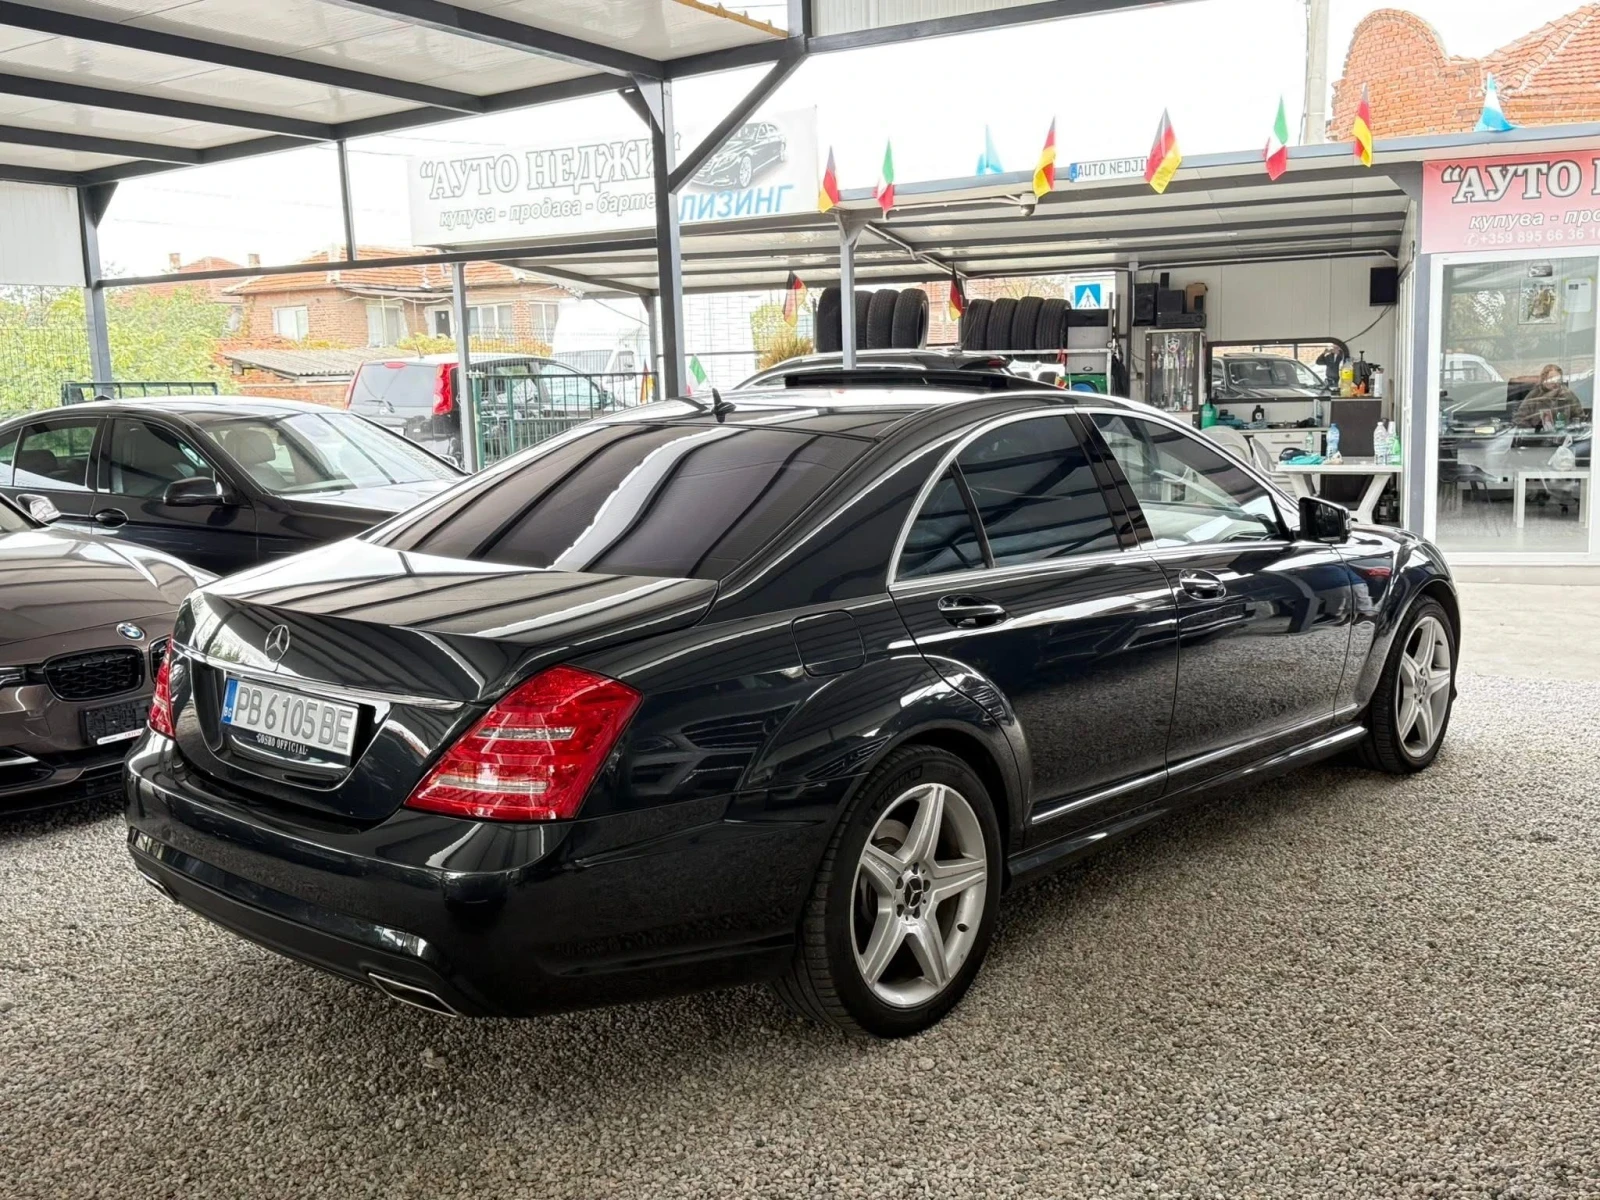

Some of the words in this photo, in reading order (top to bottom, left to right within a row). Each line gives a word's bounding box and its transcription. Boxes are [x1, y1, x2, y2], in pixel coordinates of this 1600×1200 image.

[1078, 163, 1106, 177] AUTO
[1109, 159, 1145, 174] NEDJI
[439, 207, 496, 231] купува
[509, 197, 582, 224] продава
[597, 191, 657, 217] барте
[679, 184, 795, 221] ЛИЗИНГ
[1469, 212, 1544, 232] купува
[1480, 232, 1513, 245] +359
[1517, 230, 1543, 243] 895
[1547, 229, 1564, 241] 66
[1568, 227, 1585, 240] 36
[223, 707, 233, 717] BG
